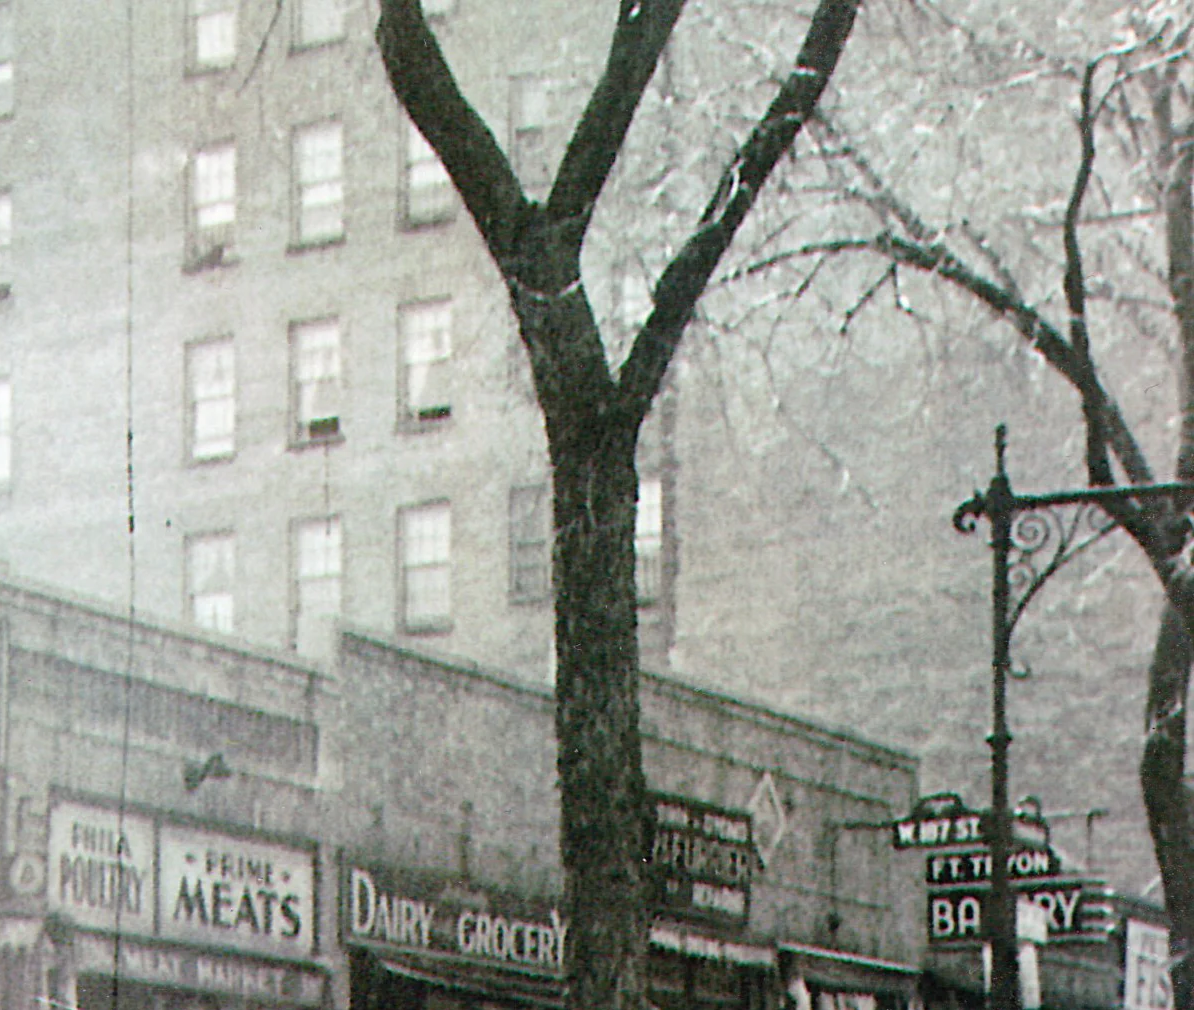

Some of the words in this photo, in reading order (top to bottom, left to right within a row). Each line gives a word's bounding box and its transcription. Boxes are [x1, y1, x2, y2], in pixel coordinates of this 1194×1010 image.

[173, 874, 303, 939] MEATS
[932, 890, 1081, 938] BARY
[458, 908, 570, 969] GROCERY
